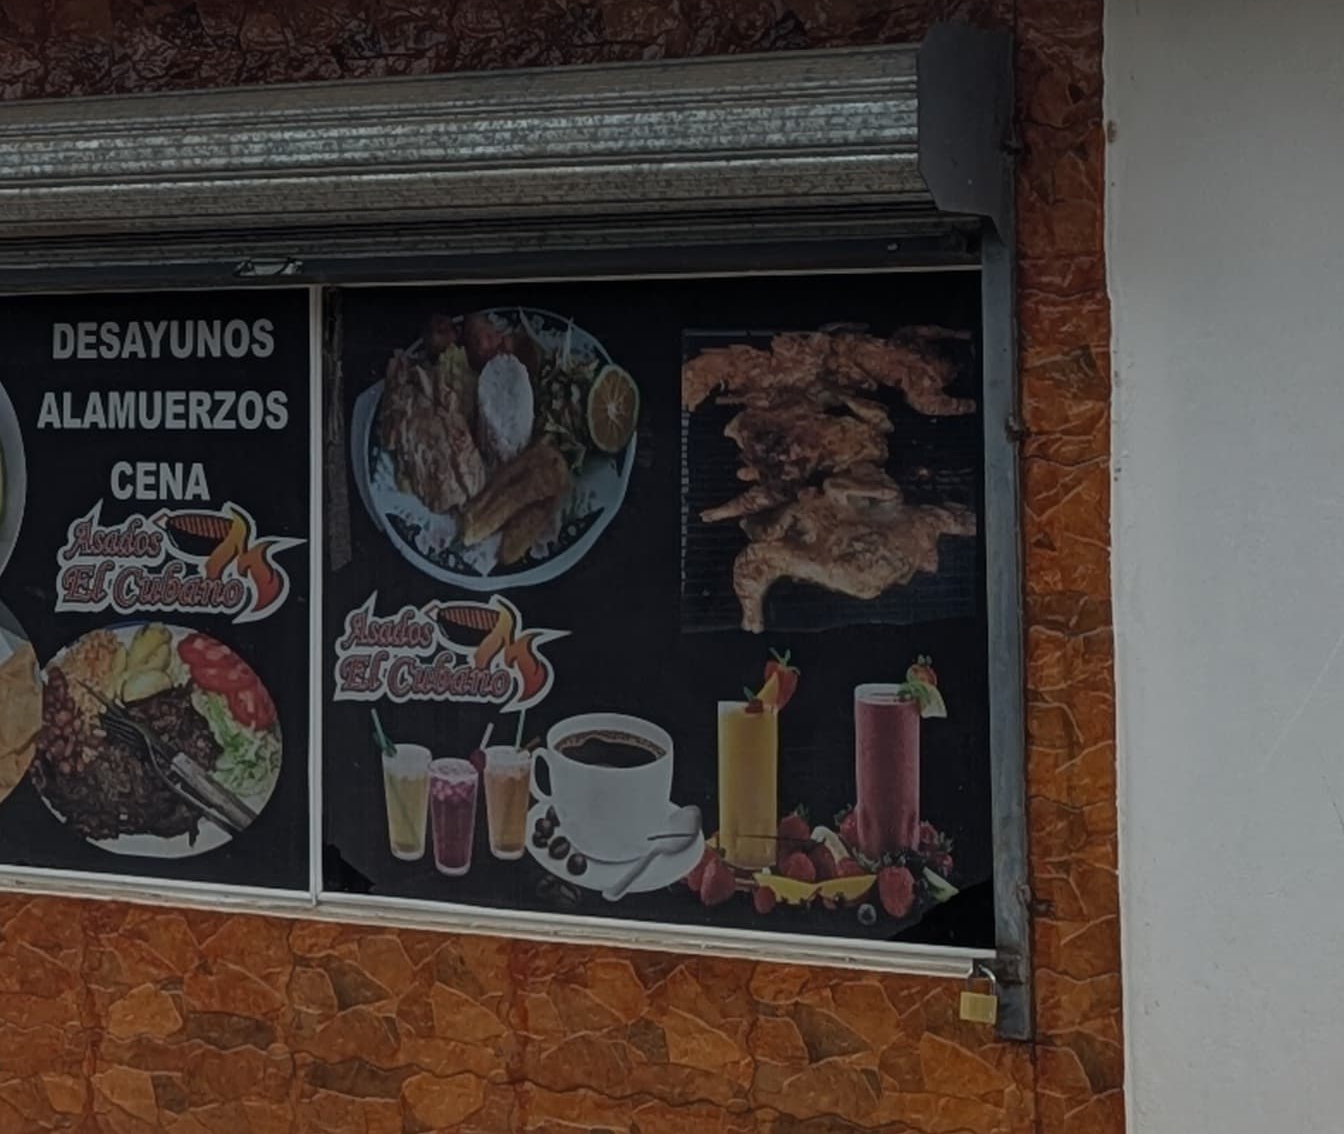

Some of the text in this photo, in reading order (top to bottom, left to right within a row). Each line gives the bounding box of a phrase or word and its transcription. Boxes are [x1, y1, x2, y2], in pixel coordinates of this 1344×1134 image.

[52, 319, 275, 360] DESAYUNOS
[36, 390, 289, 430] ALAMUERZOS
[110, 462, 210, 501] CENA
[63, 517, 165, 561] Asados
[62, 561, 244, 608] El Cubano
[342, 610, 434, 650] Asados
[339, 650, 513, 698] El Cubano
